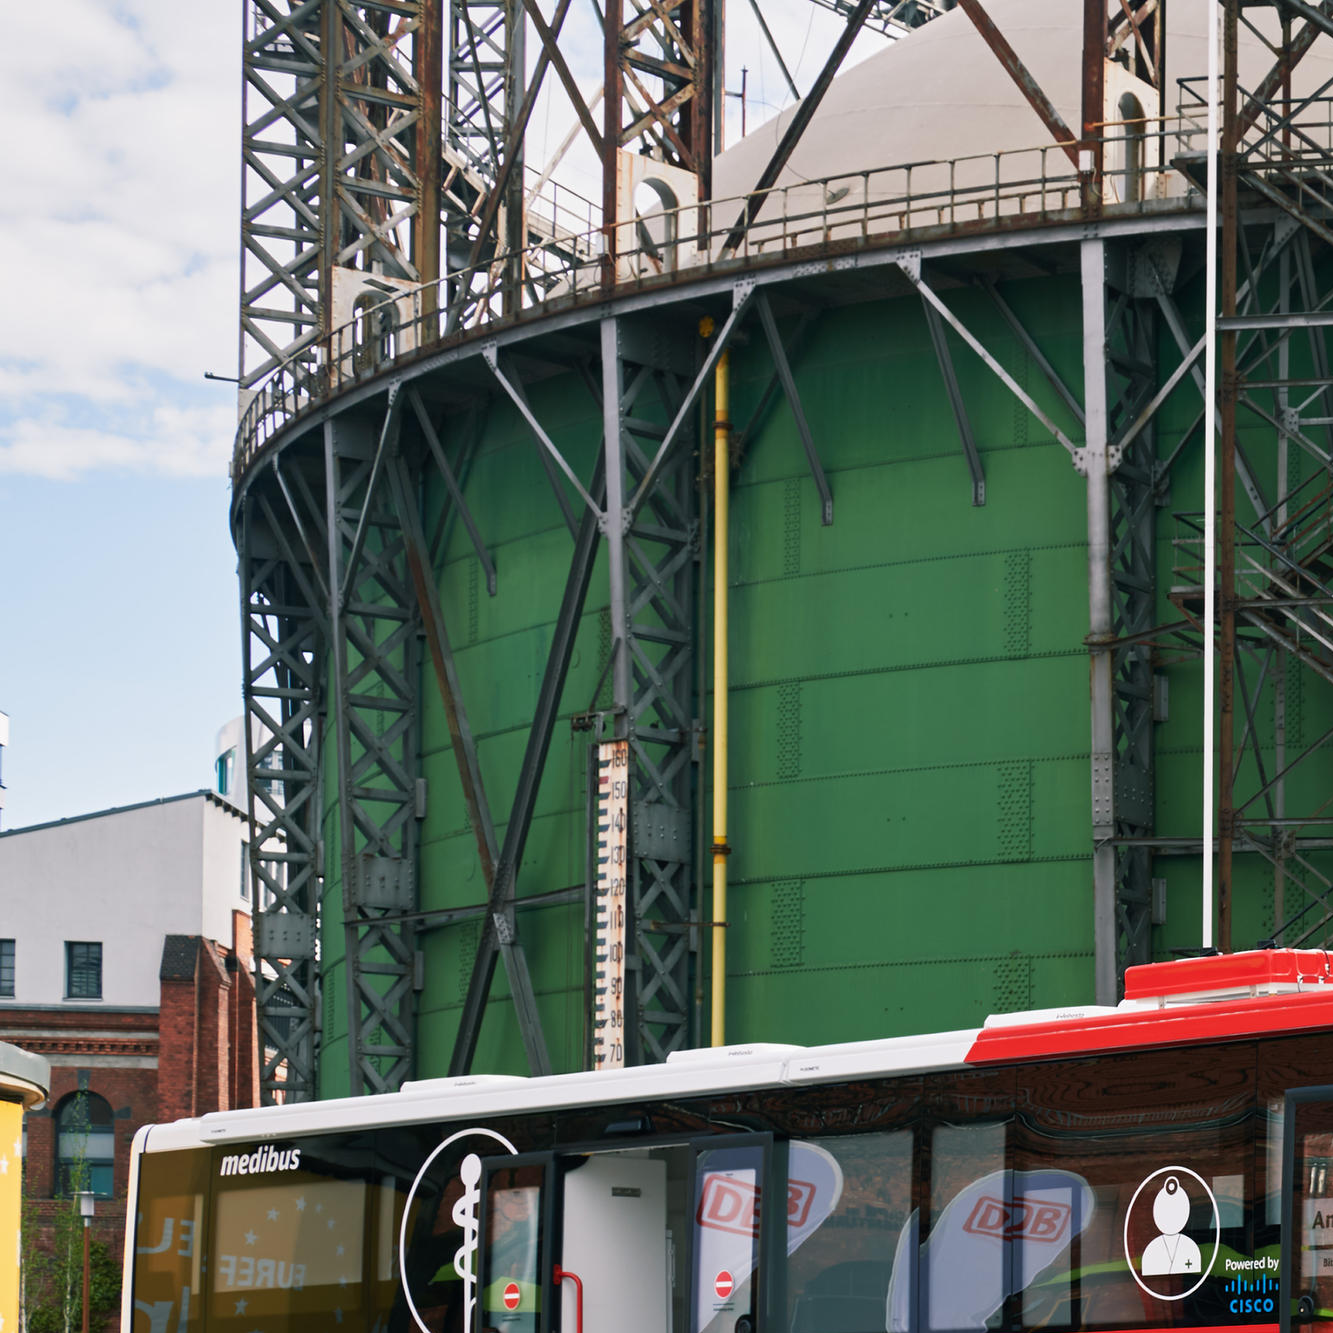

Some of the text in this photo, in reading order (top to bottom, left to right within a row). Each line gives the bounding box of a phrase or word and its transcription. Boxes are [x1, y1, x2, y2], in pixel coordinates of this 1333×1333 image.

[612, 749, 627, 769] 160
[612, 781, 626, 800] 150
[611, 813, 626, 833] 140
[611, 845, 625, 864] 130
[610, 878, 624, 897] 120
[610, 910, 624, 930] 110
[610, 943, 623, 963] 100
[611, 977, 622, 995] 90
[610, 1010, 622, 1028] 80
[610, 1043, 623, 1062] 70
[219, 1145, 302, 1176] medibus
[1225, 1256, 1280, 1272] Powered by
[1229, 1298, 1274, 1313] CISCO
